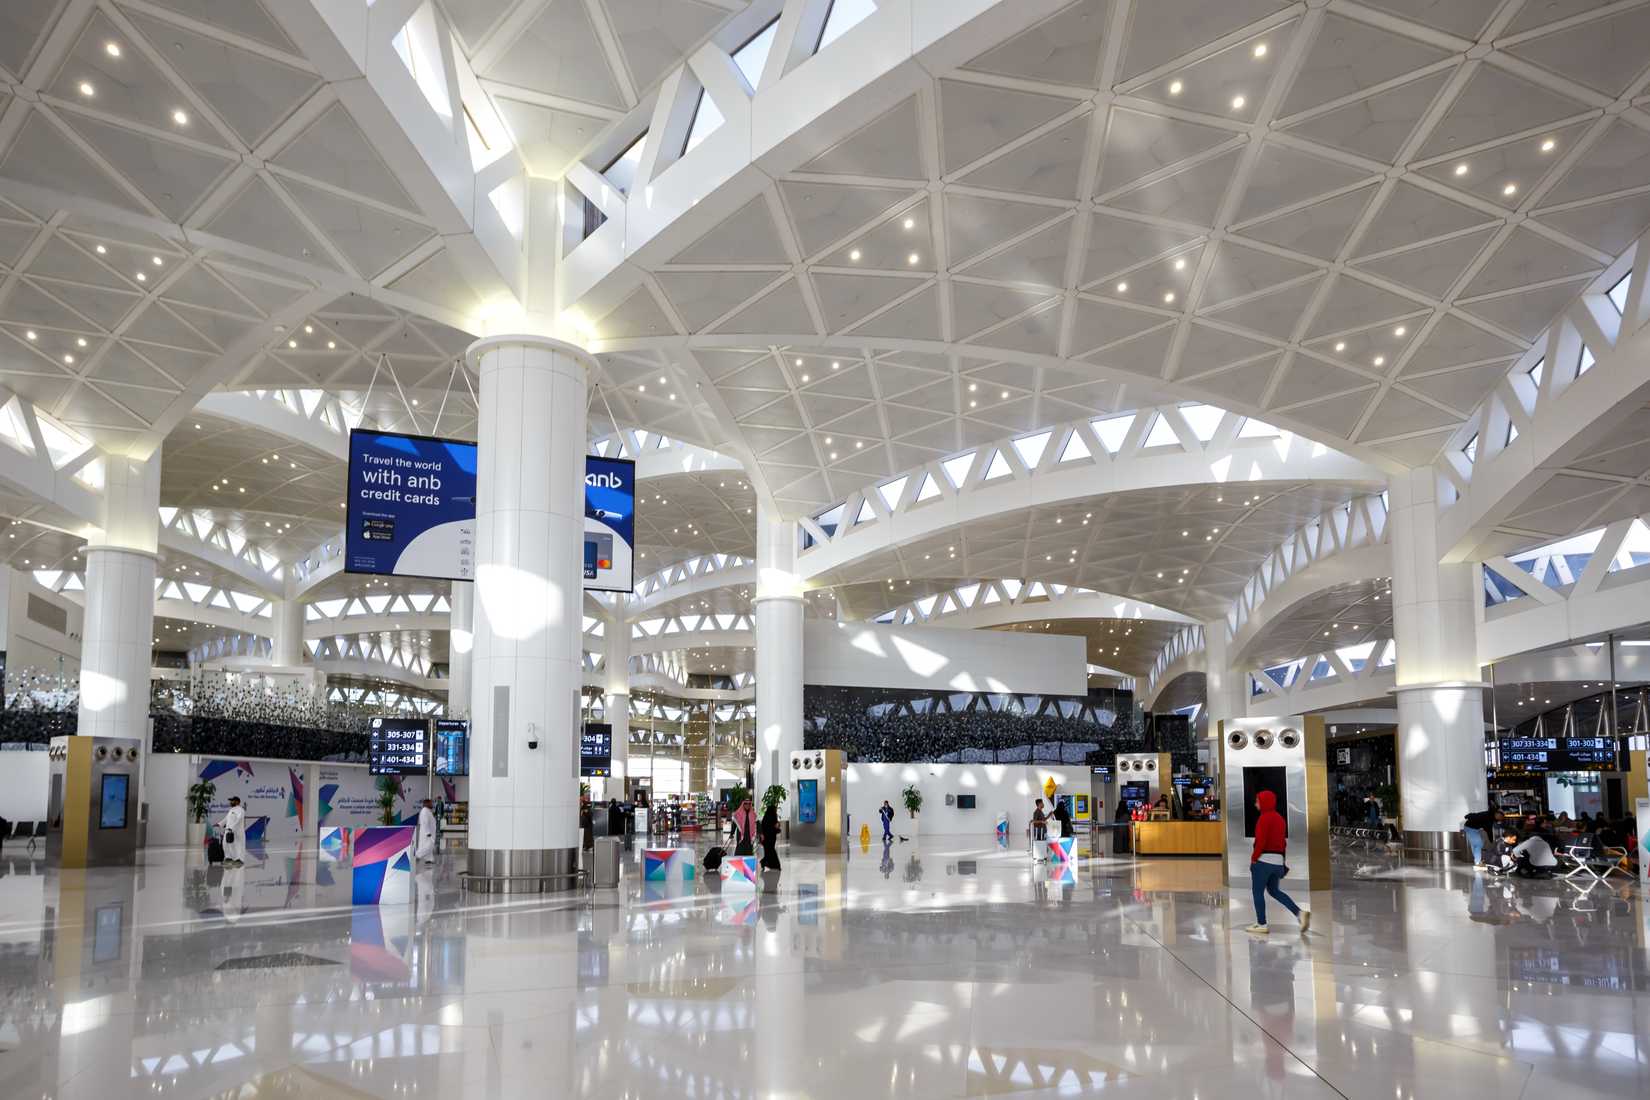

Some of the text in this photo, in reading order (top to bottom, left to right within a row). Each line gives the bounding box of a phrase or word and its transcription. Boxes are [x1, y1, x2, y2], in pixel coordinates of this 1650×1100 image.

[363, 453, 442, 471] Travel the world
[363, 469, 442, 490] with anb
[585, 471, 622, 489] anb
[361, 489, 440, 505] credit cards
[387, 743, 415, 751] 331-334
[1568, 739, 1594, 747] 301-302
[1512, 753, 1539, 761] 401-434
